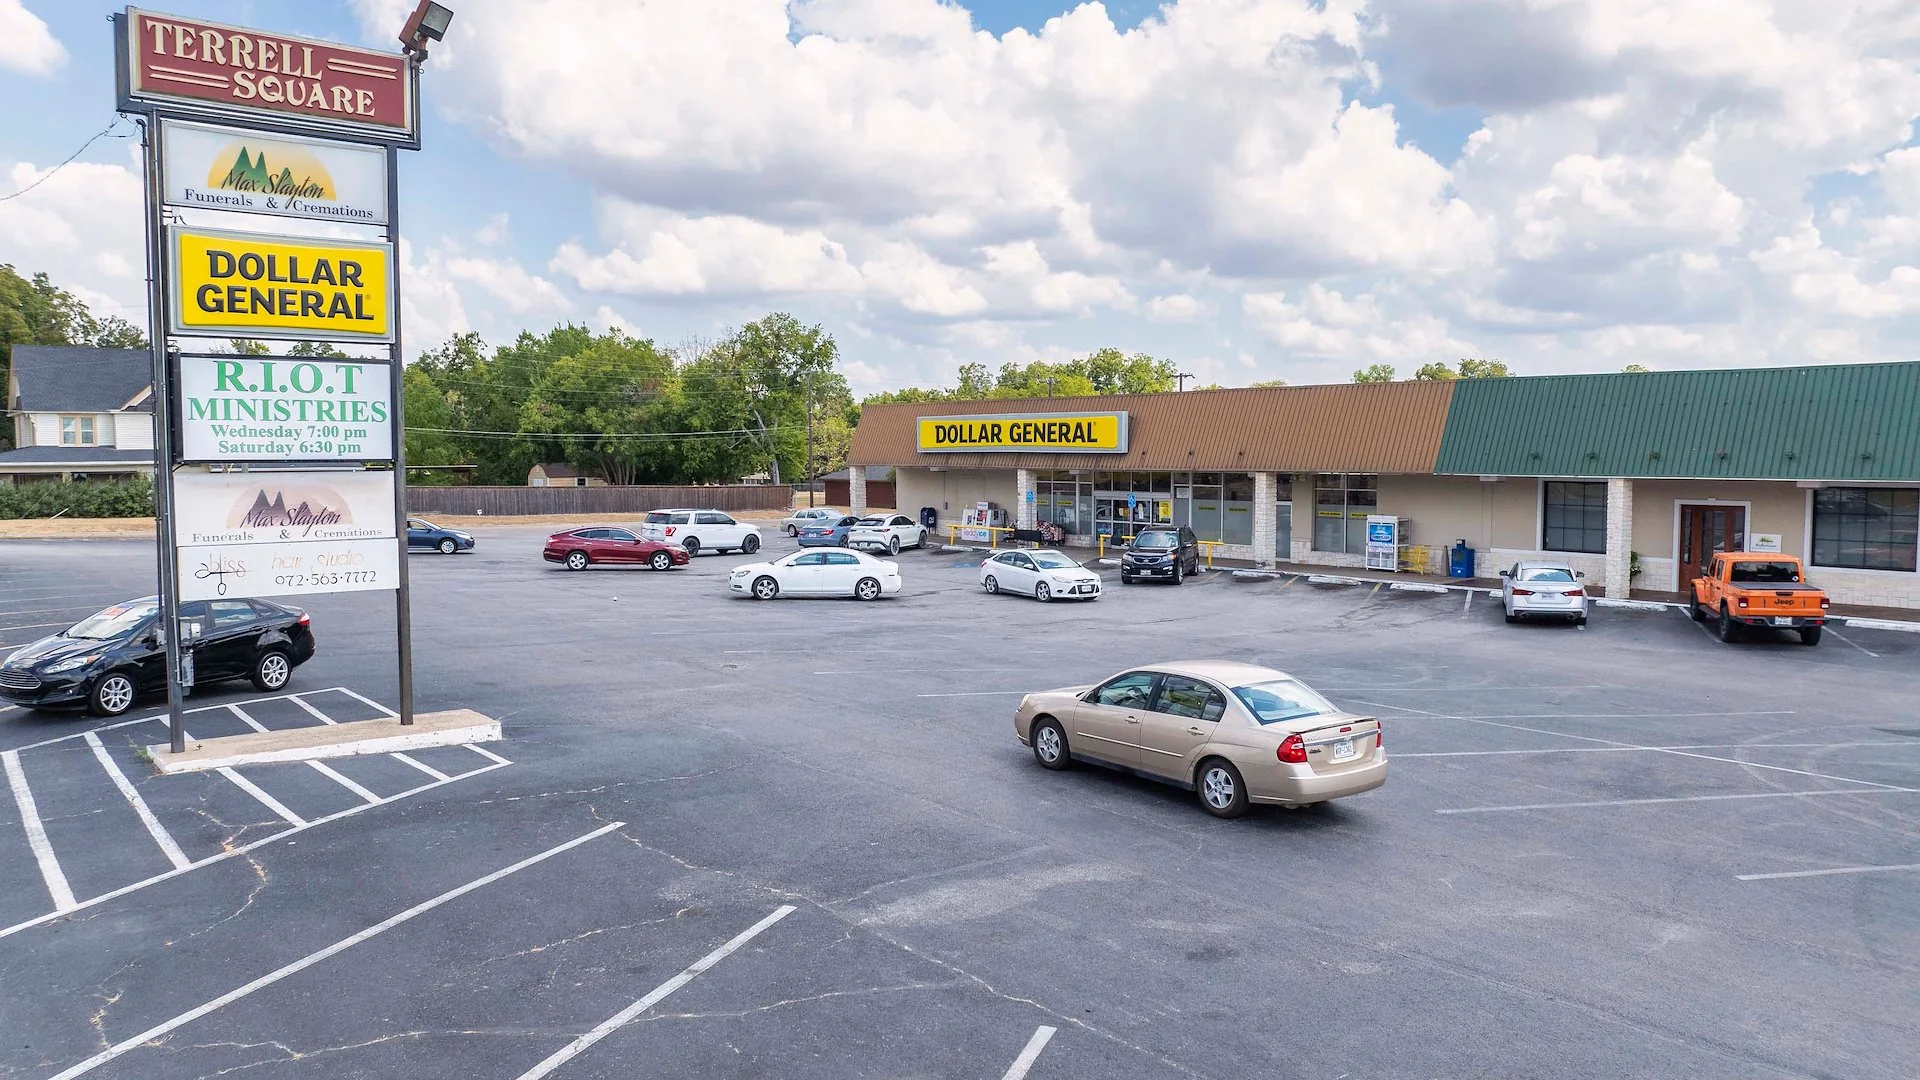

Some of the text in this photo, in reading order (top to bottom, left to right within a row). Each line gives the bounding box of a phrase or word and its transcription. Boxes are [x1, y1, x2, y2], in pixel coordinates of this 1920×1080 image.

[145, 19, 323, 81] TERRELL
[232, 70, 375, 117] SQUARE
[184, 188, 374, 219] Funerals & Cremations
[220, 170, 327, 210] Max Slayton
[206, 250, 364, 288] DOLLAR
[196, 284, 374, 320] GENERAL
[213, 360, 363, 395] R.I.O.T
[187, 397, 388, 423] MINISTRIES
[210, 424, 367, 441] Wednesday 7:00 pm
[218, 440, 361, 456] Saturday 6:30 pm
[935, 421, 1098, 444] DOLLAR GENERAL
[192, 528, 383, 543] Funerals & Cremations
[239, 506, 341, 537] Max Slayton
[271, 552, 303, 570] hair
[1774, 598, 1794, 606] Jeep
